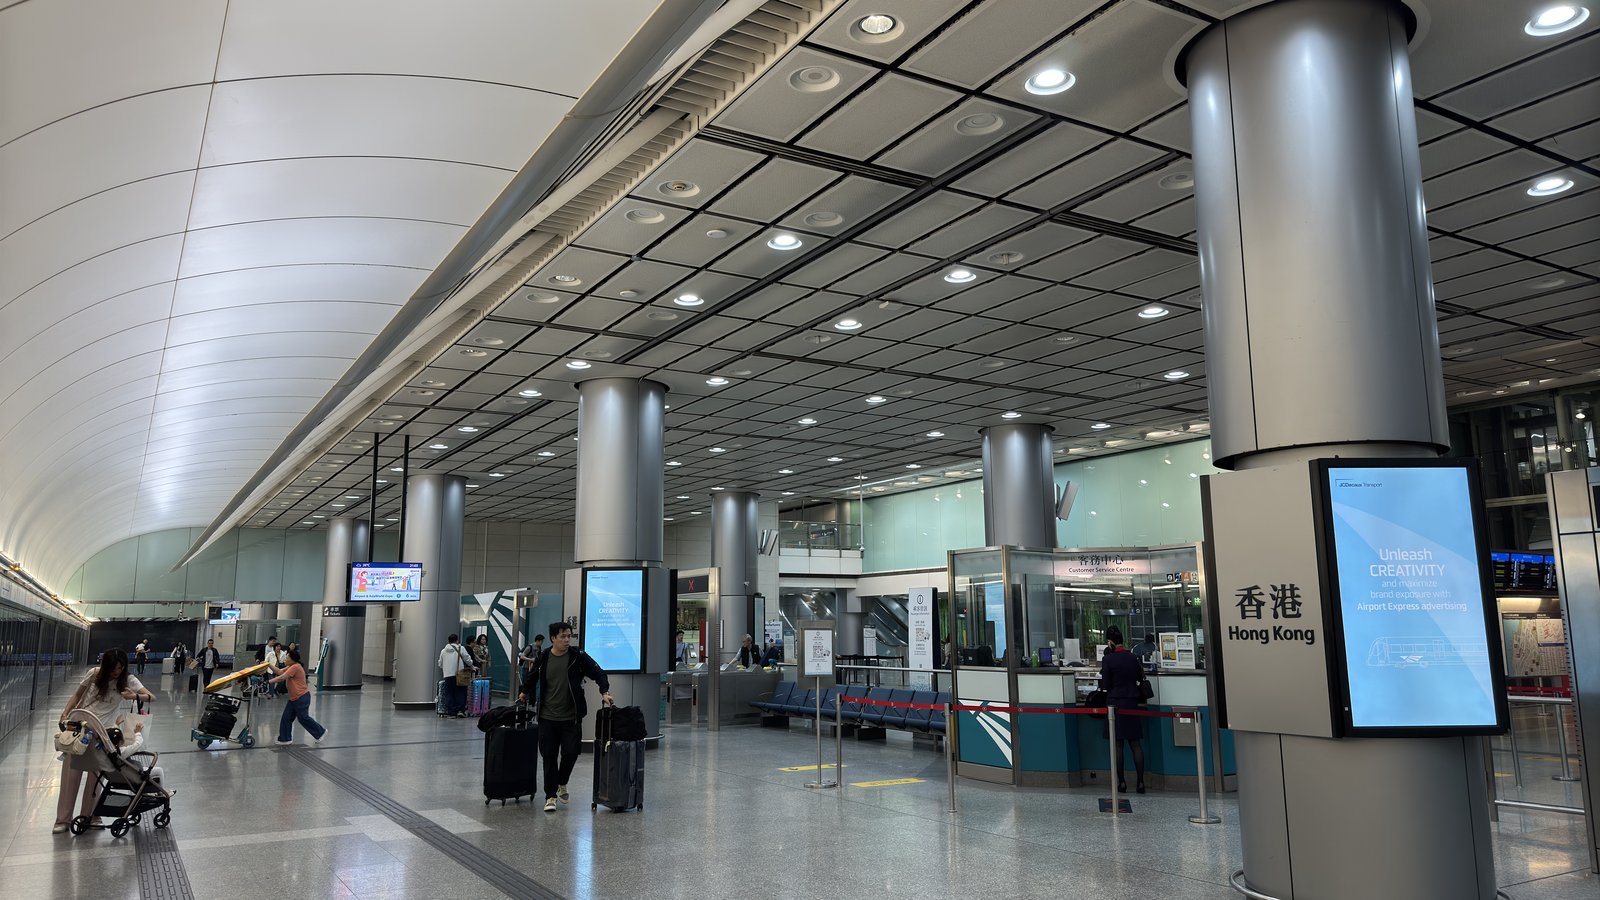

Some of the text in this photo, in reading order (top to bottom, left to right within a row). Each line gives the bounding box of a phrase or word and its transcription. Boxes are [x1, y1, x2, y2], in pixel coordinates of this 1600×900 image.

[1078, 554, 1124, 566] 客務中心
[1380, 548, 1432, 561] Unleash
[1369, 564, 1445, 577] CREATIVITY
[1382, 579, 1438, 588] and maximize
[1370, 590, 1451, 600] brand exposure with
[1235, 584, 1303, 620] 香港
[1357, 602, 1468, 612] Airport Express advertising
[1228, 625, 1315, 646] Hong Kong
